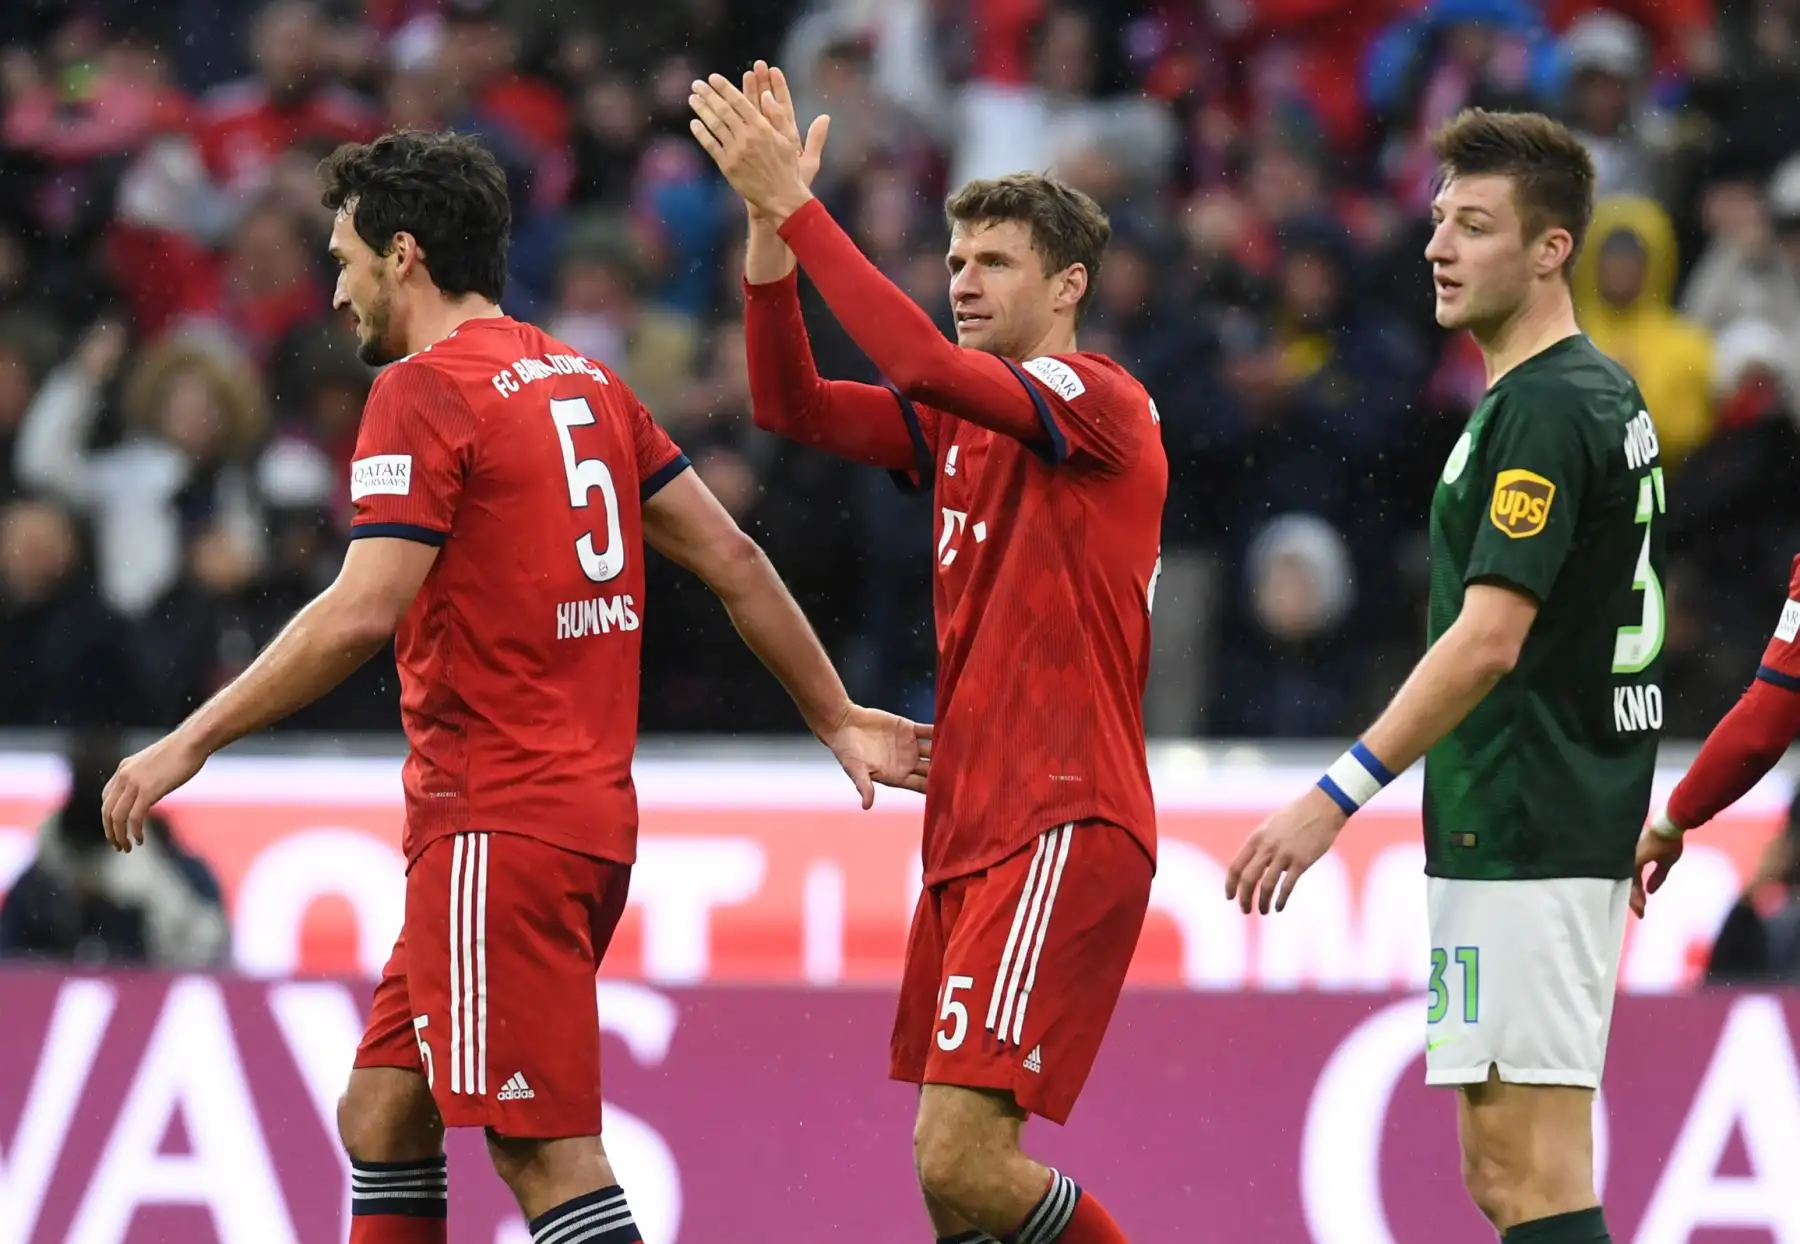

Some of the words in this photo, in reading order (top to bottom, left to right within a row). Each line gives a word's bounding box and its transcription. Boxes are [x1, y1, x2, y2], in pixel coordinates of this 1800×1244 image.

[491, 369, 520, 399] FC
[354, 462, 407, 484] QATAR
[364, 478, 407, 488] AIRWAYS
[550, 396, 625, 583] 5
[1496, 489, 1546, 527] ups
[1613, 683, 1663, 733] KNO
[1426, 946, 1480, 1024] 31
[936, 975, 974, 1051] 5
[497, 1088, 535, 1101] adidas
